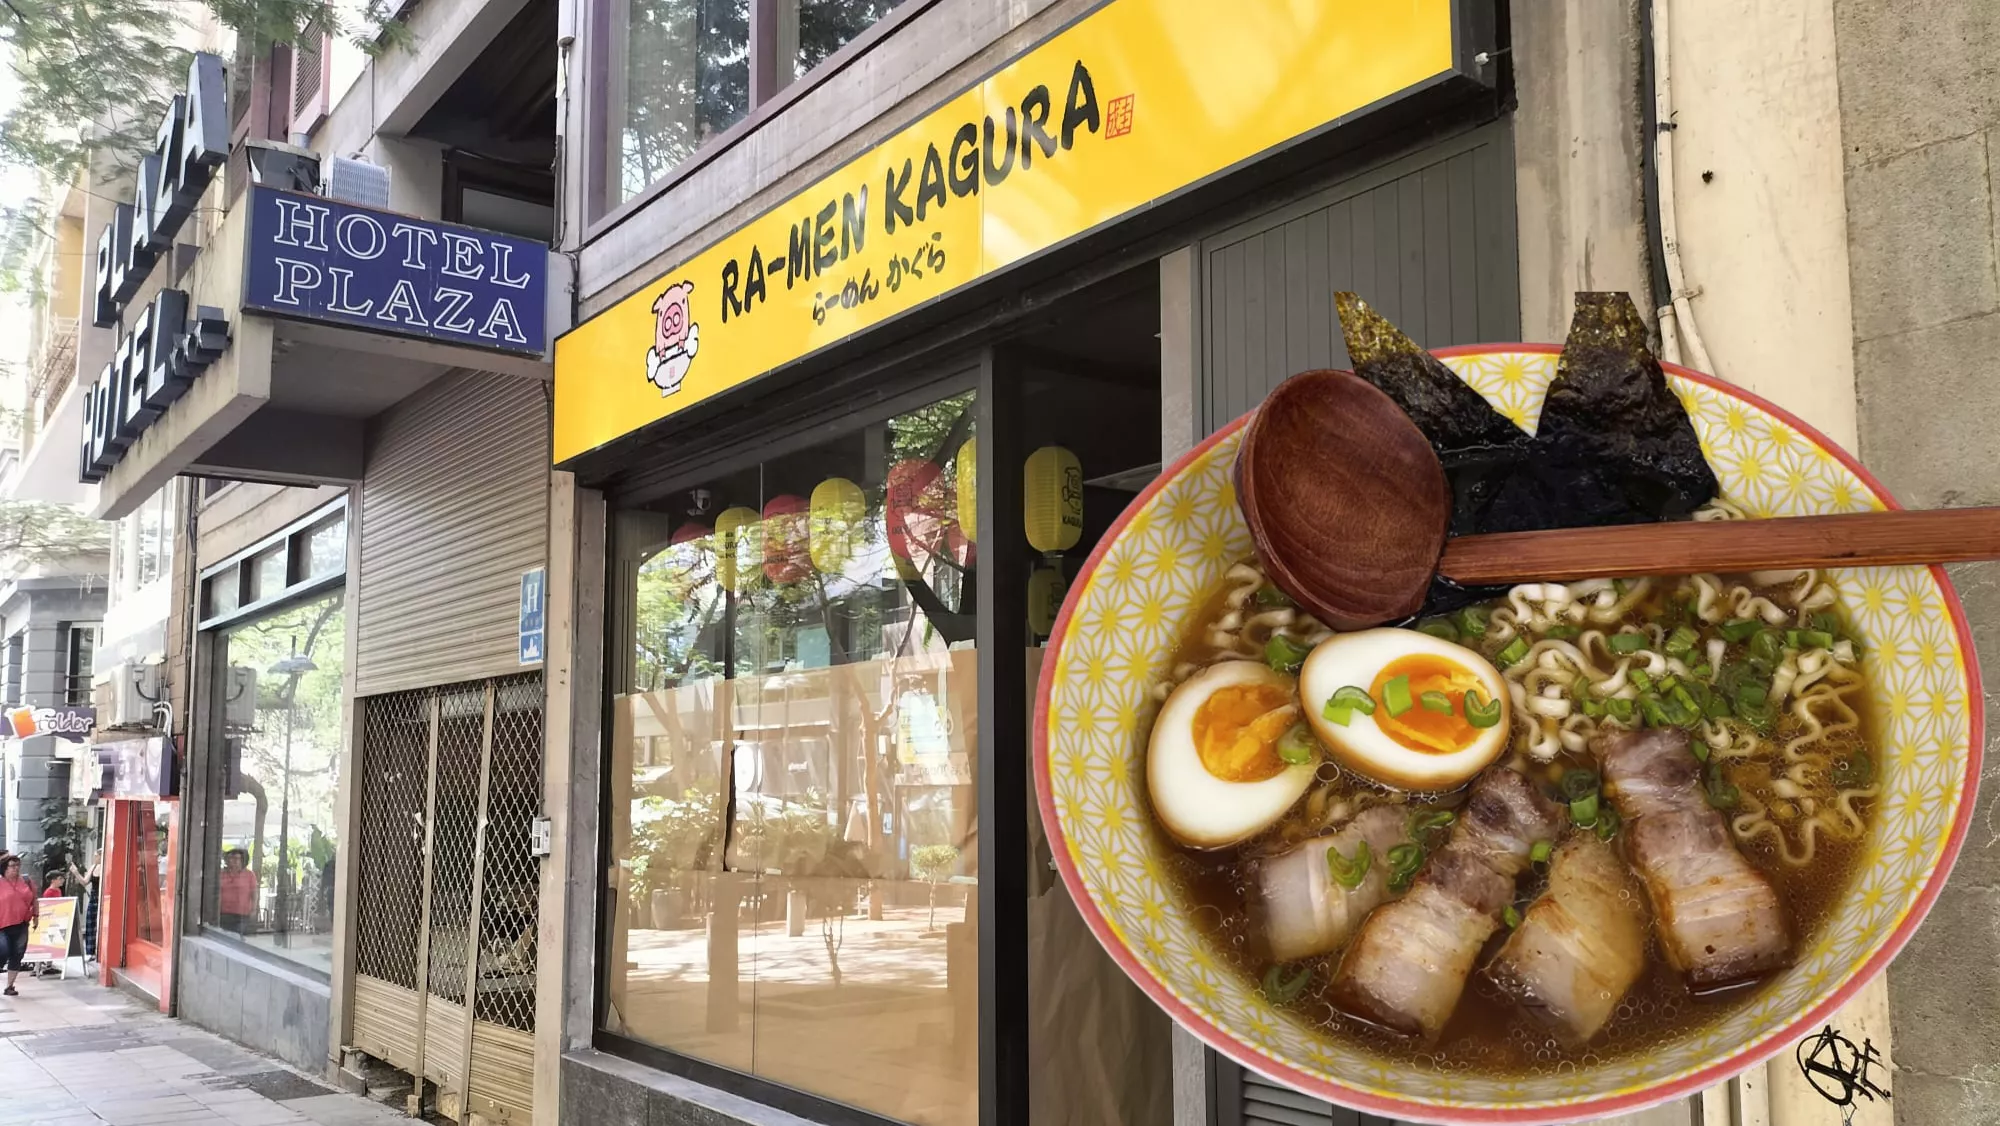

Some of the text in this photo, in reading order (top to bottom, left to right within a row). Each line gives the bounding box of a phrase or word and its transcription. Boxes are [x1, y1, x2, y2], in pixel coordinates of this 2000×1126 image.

[94, 53, 227, 328] PLAZA
[722, 61, 1100, 323] RA-MEN KAGURA
[274, 198, 530, 289] HOTEL
[812, 233, 945, 326] らーめん かぐら
[273, 258, 528, 344] PLAZA
[79, 289, 189, 484] HOTEL
[525, 582, 538, 613] H
